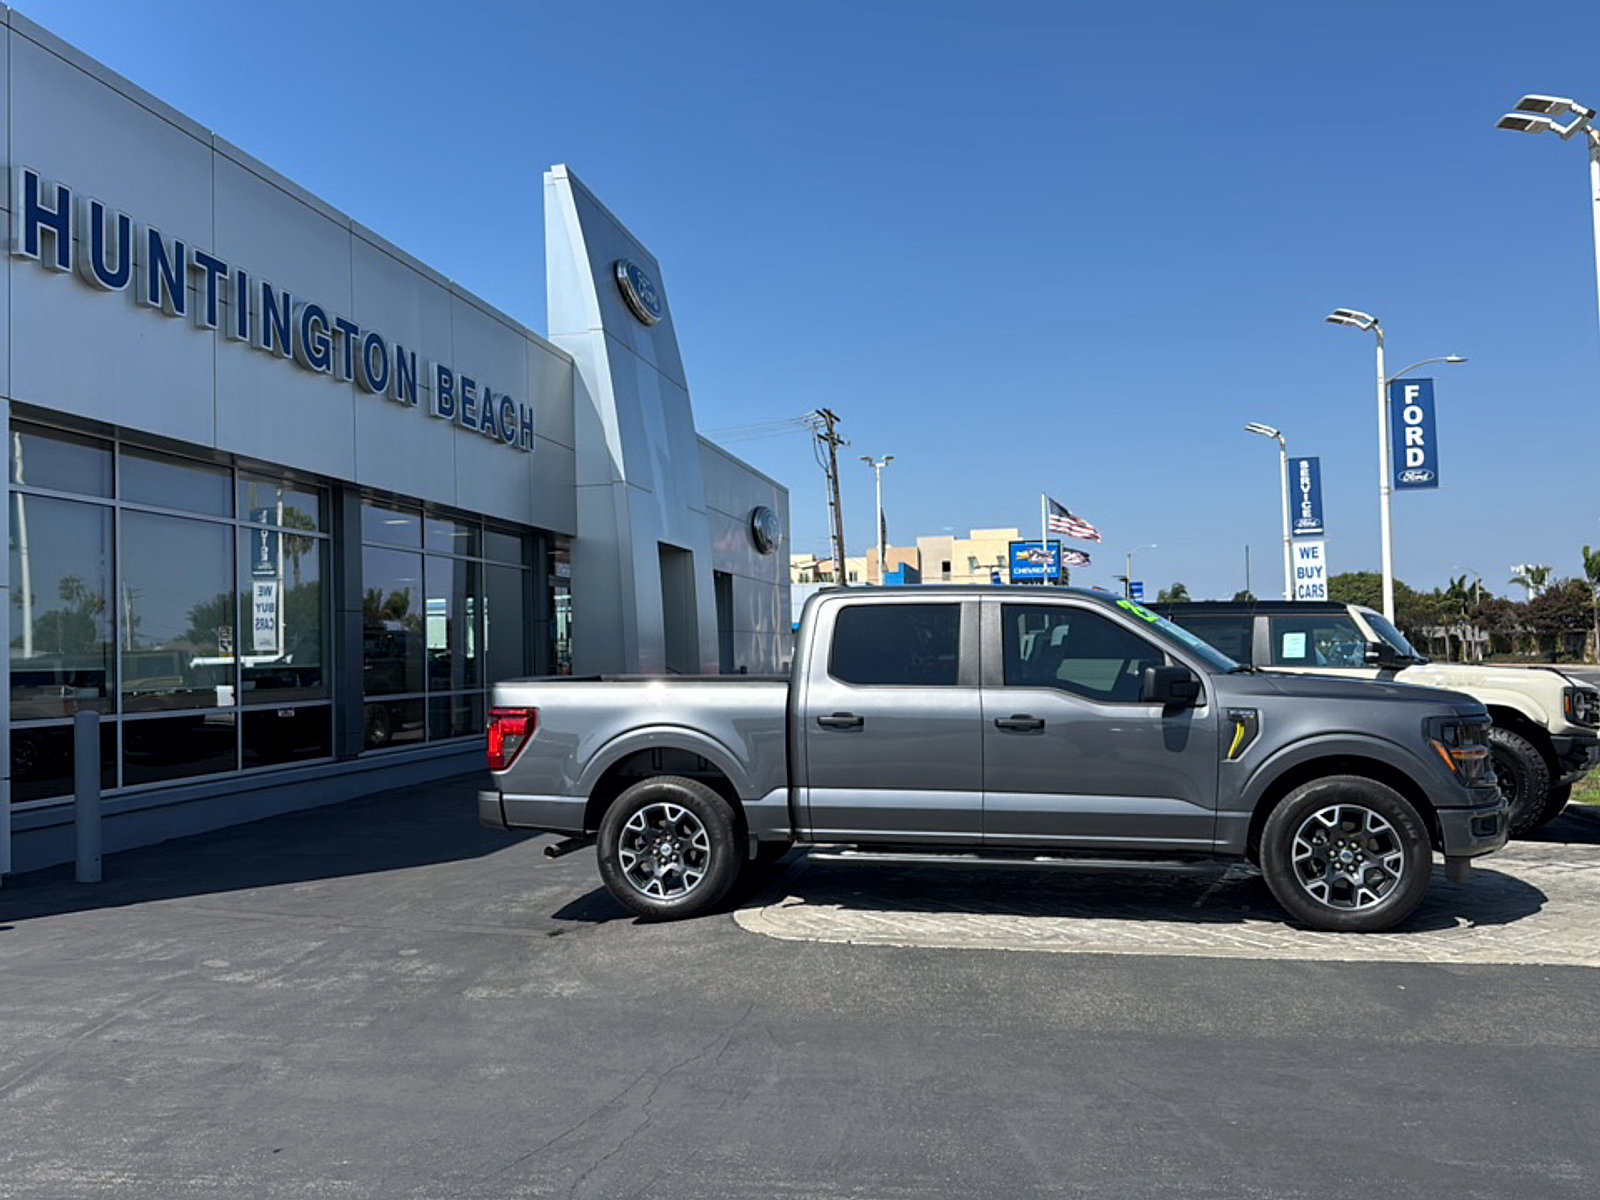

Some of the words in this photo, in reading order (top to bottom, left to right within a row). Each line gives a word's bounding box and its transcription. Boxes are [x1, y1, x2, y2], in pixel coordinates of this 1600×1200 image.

[14, 167, 419, 407] HUNTINGTON
[430, 362, 535, 452] BEACH
[1403, 385, 1424, 468] FORD
[1299, 460, 1312, 518] SERVICE
[1299, 547, 1319, 559] WE
[1297, 566, 1323, 579] BUY
[1298, 584, 1325, 599] CARS
